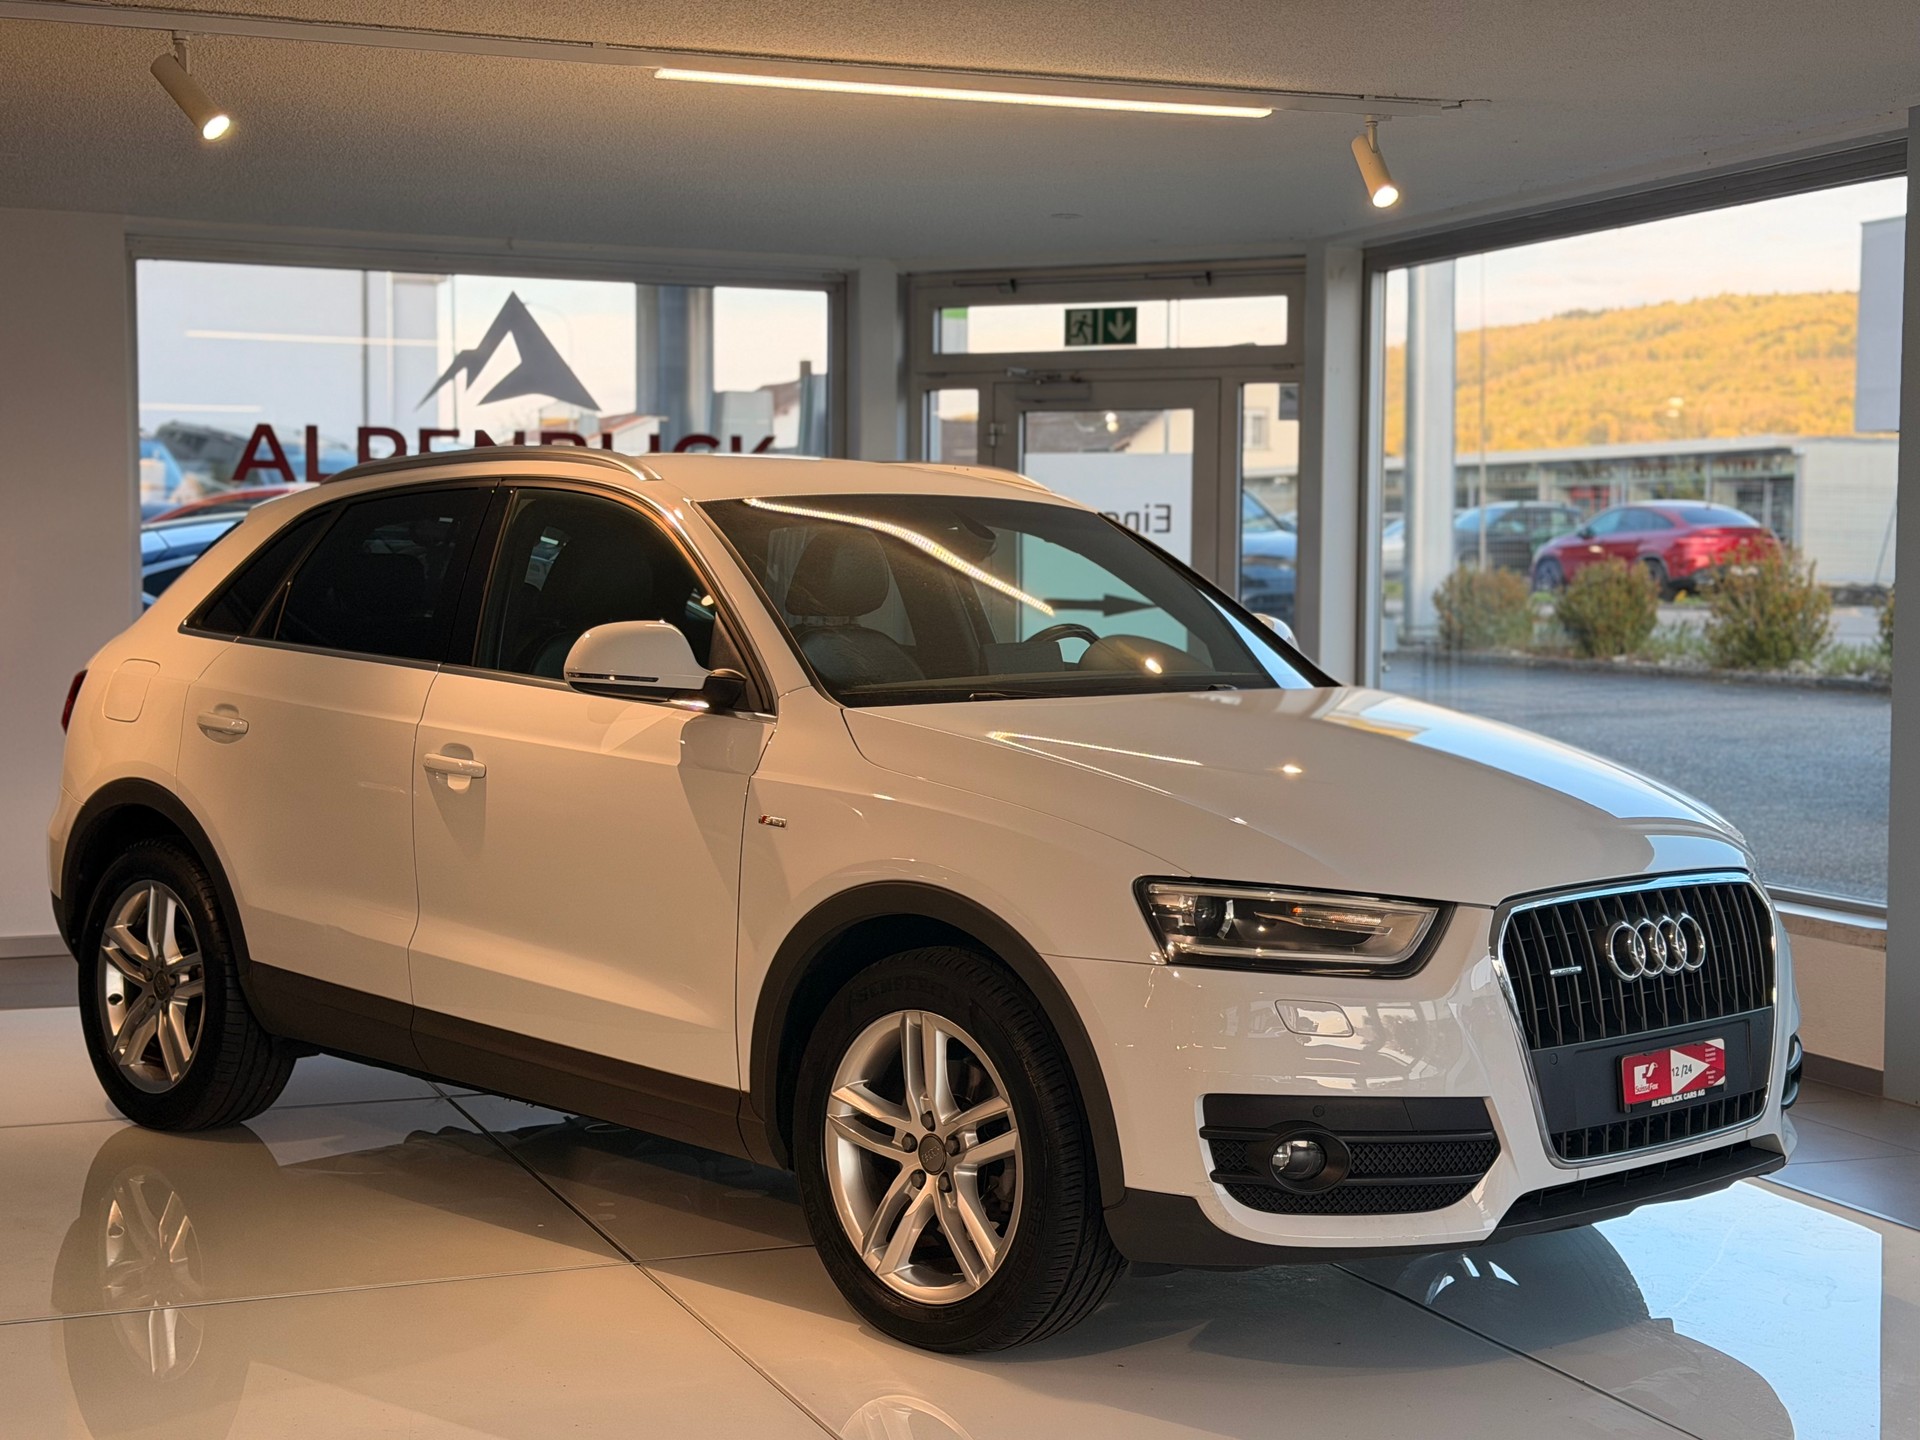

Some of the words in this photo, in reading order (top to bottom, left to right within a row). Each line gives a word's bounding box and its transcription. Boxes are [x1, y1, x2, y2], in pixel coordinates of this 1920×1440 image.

[1651, 1094, 1683, 1108] ALPENBLICK
[1683, 1090, 1697, 1100] CARS
[1697, 1088, 1705, 1097] AG
